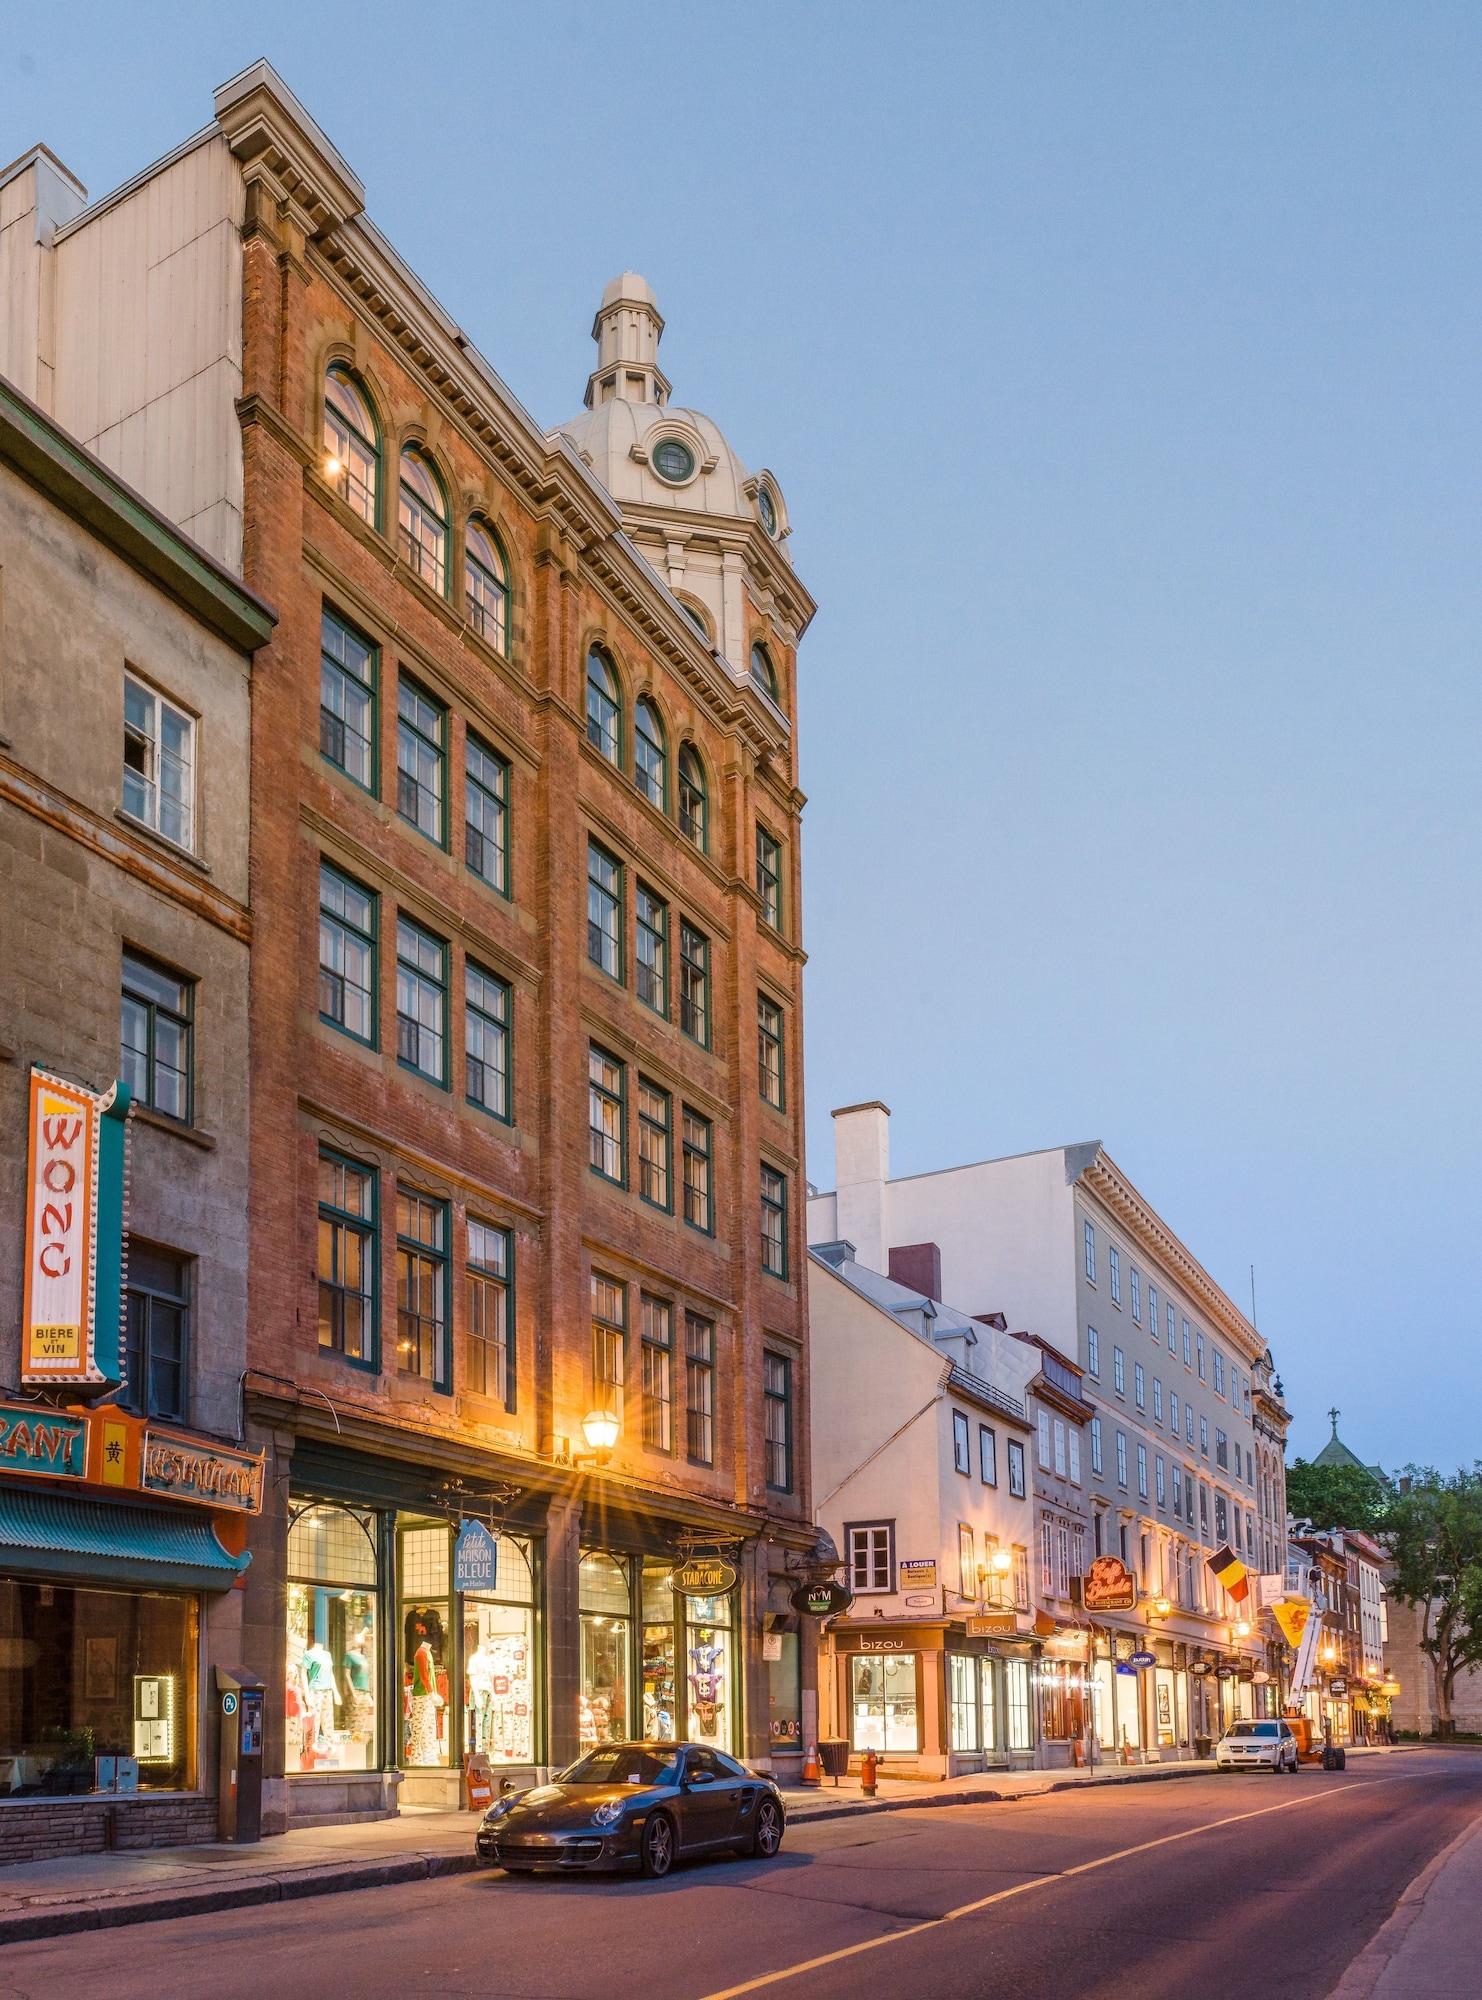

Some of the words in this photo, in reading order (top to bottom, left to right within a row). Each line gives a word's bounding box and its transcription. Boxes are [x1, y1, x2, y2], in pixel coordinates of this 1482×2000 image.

[40, 1118, 83, 1278] WONG
[43, 1344, 65, 1353] VIN
[462, 1531, 486, 1549] Petite
[458, 1549, 492, 1562] MAISON
[458, 1562, 492, 1578] BLEUE
[682, 1566, 723, 1586] STADACONÉ
[808, 1590, 832, 1601] NYM
[970, 1619, 1011, 1634] bizou
[860, 1634, 904, 1650] bizou
